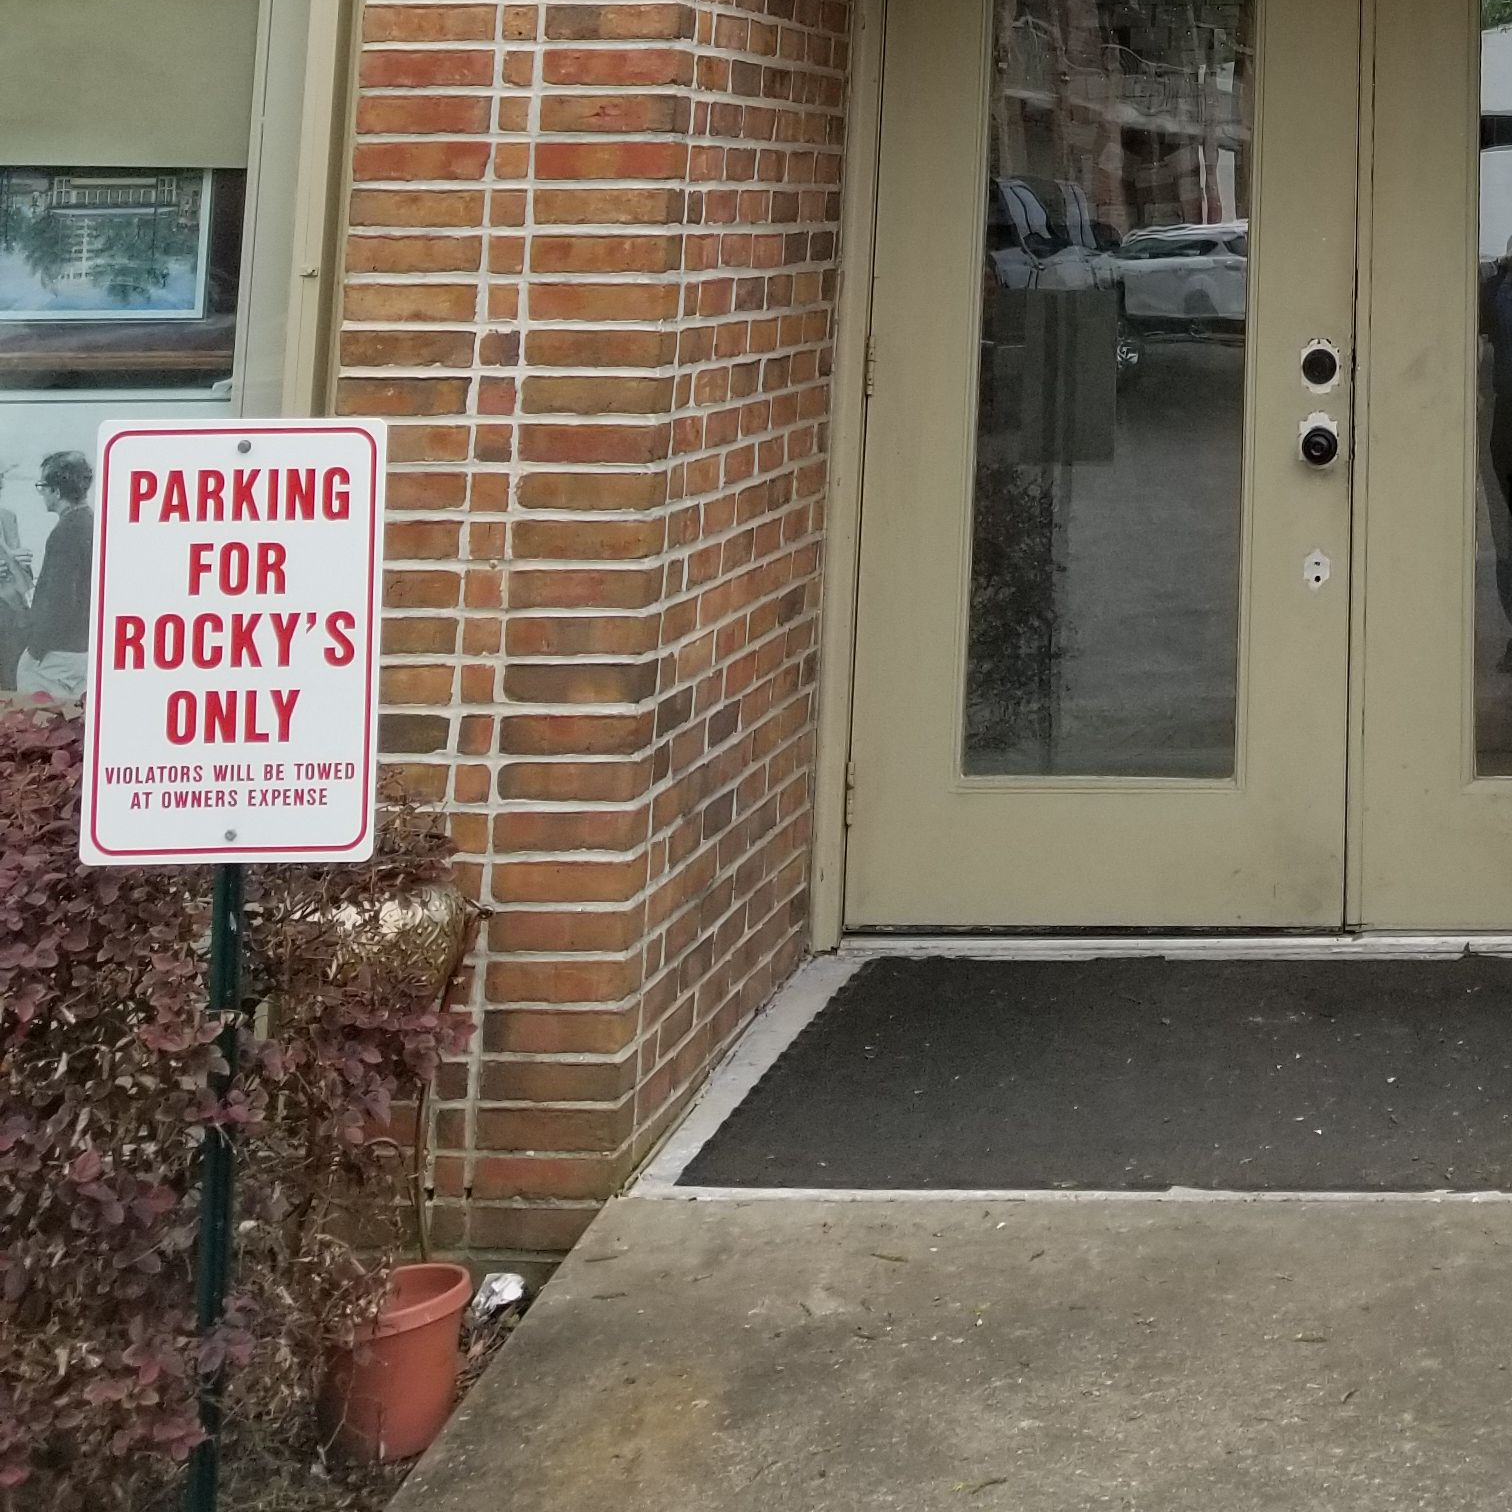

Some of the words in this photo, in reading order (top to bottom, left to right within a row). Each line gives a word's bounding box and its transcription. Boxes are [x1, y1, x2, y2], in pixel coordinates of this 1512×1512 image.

[129, 467, 350, 524] PARKING
[188, 541, 286, 596] FOR
[114, 610, 356, 670] ROCKY'S
[166, 689, 300, 745] ONLY
[105, 765, 203, 785] VIOLATORS
[213, 764, 255, 782] WILL
[263, 763, 285, 781] BE
[294, 762, 355, 780] TOWED
[130, 792, 153, 809] AT
[161, 790, 238, 808] OWNERS
[247, 787, 328, 806] EXPENSE
